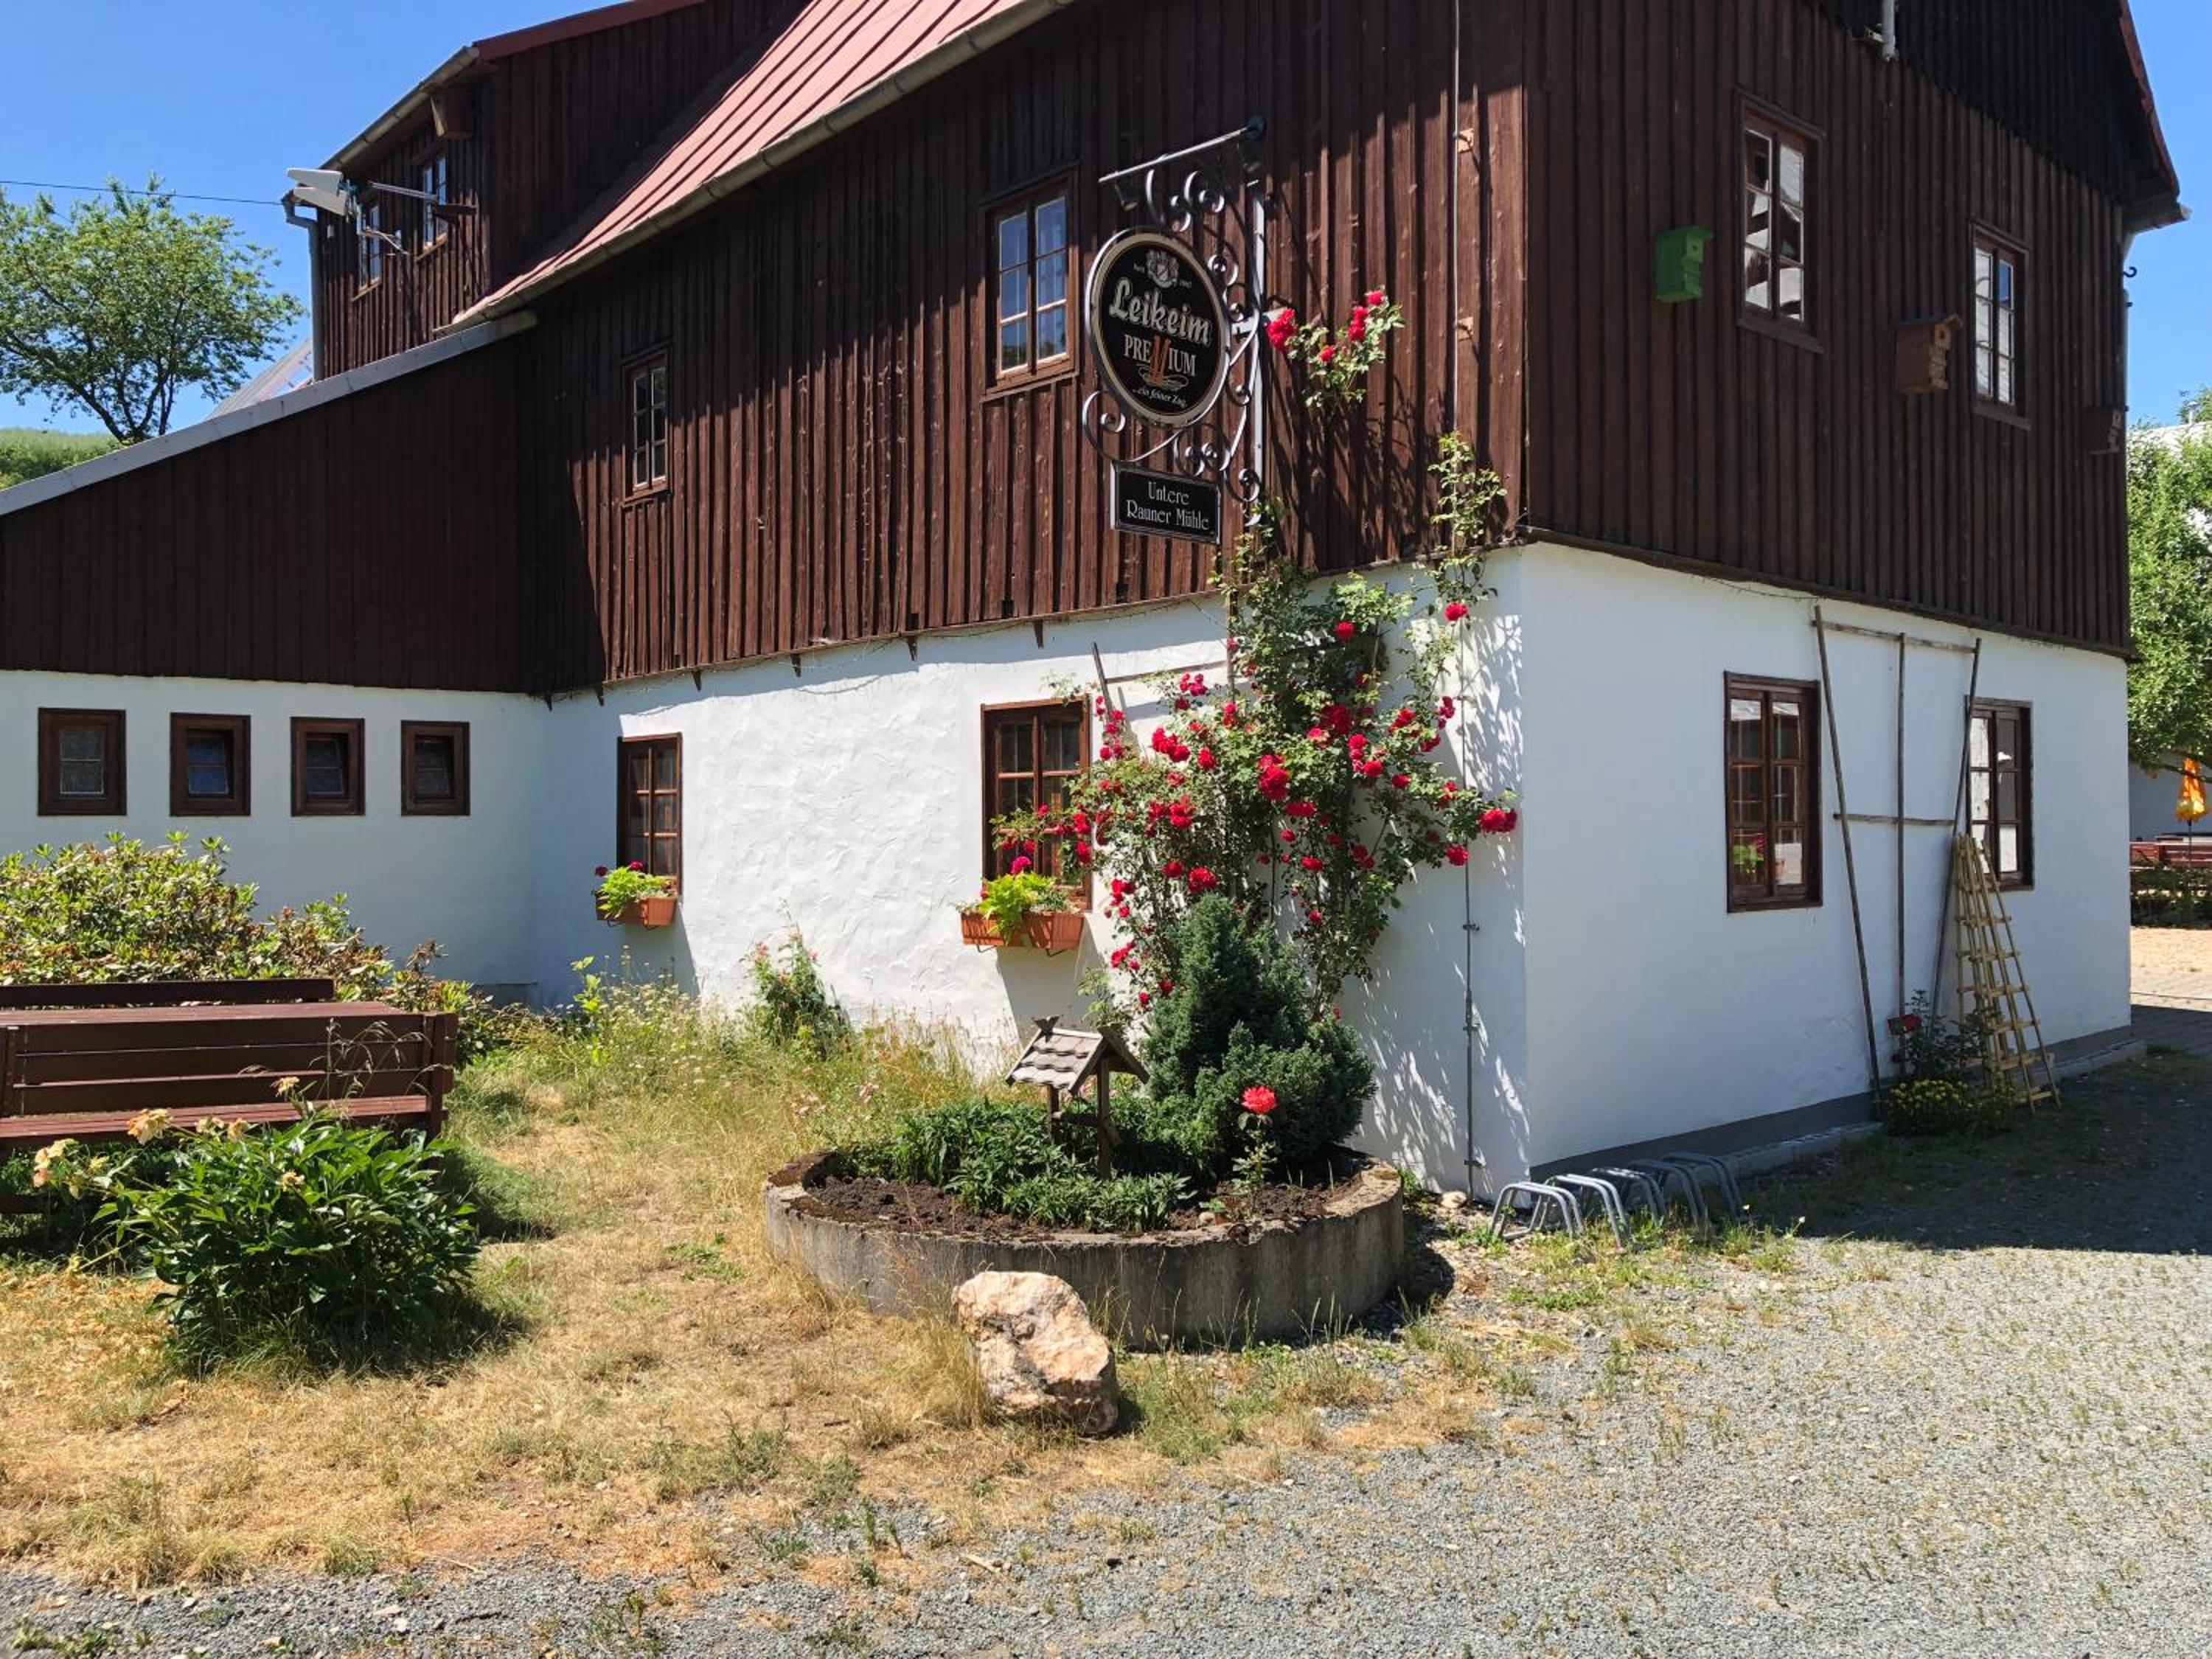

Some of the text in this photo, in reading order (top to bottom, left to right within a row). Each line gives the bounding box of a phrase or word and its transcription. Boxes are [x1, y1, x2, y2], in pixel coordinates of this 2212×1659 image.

[1109, 277, 1212, 347] Leikeim
[1147, 481, 1189, 505] Untere
[1126, 499, 1209, 530] Rauner Mühle
